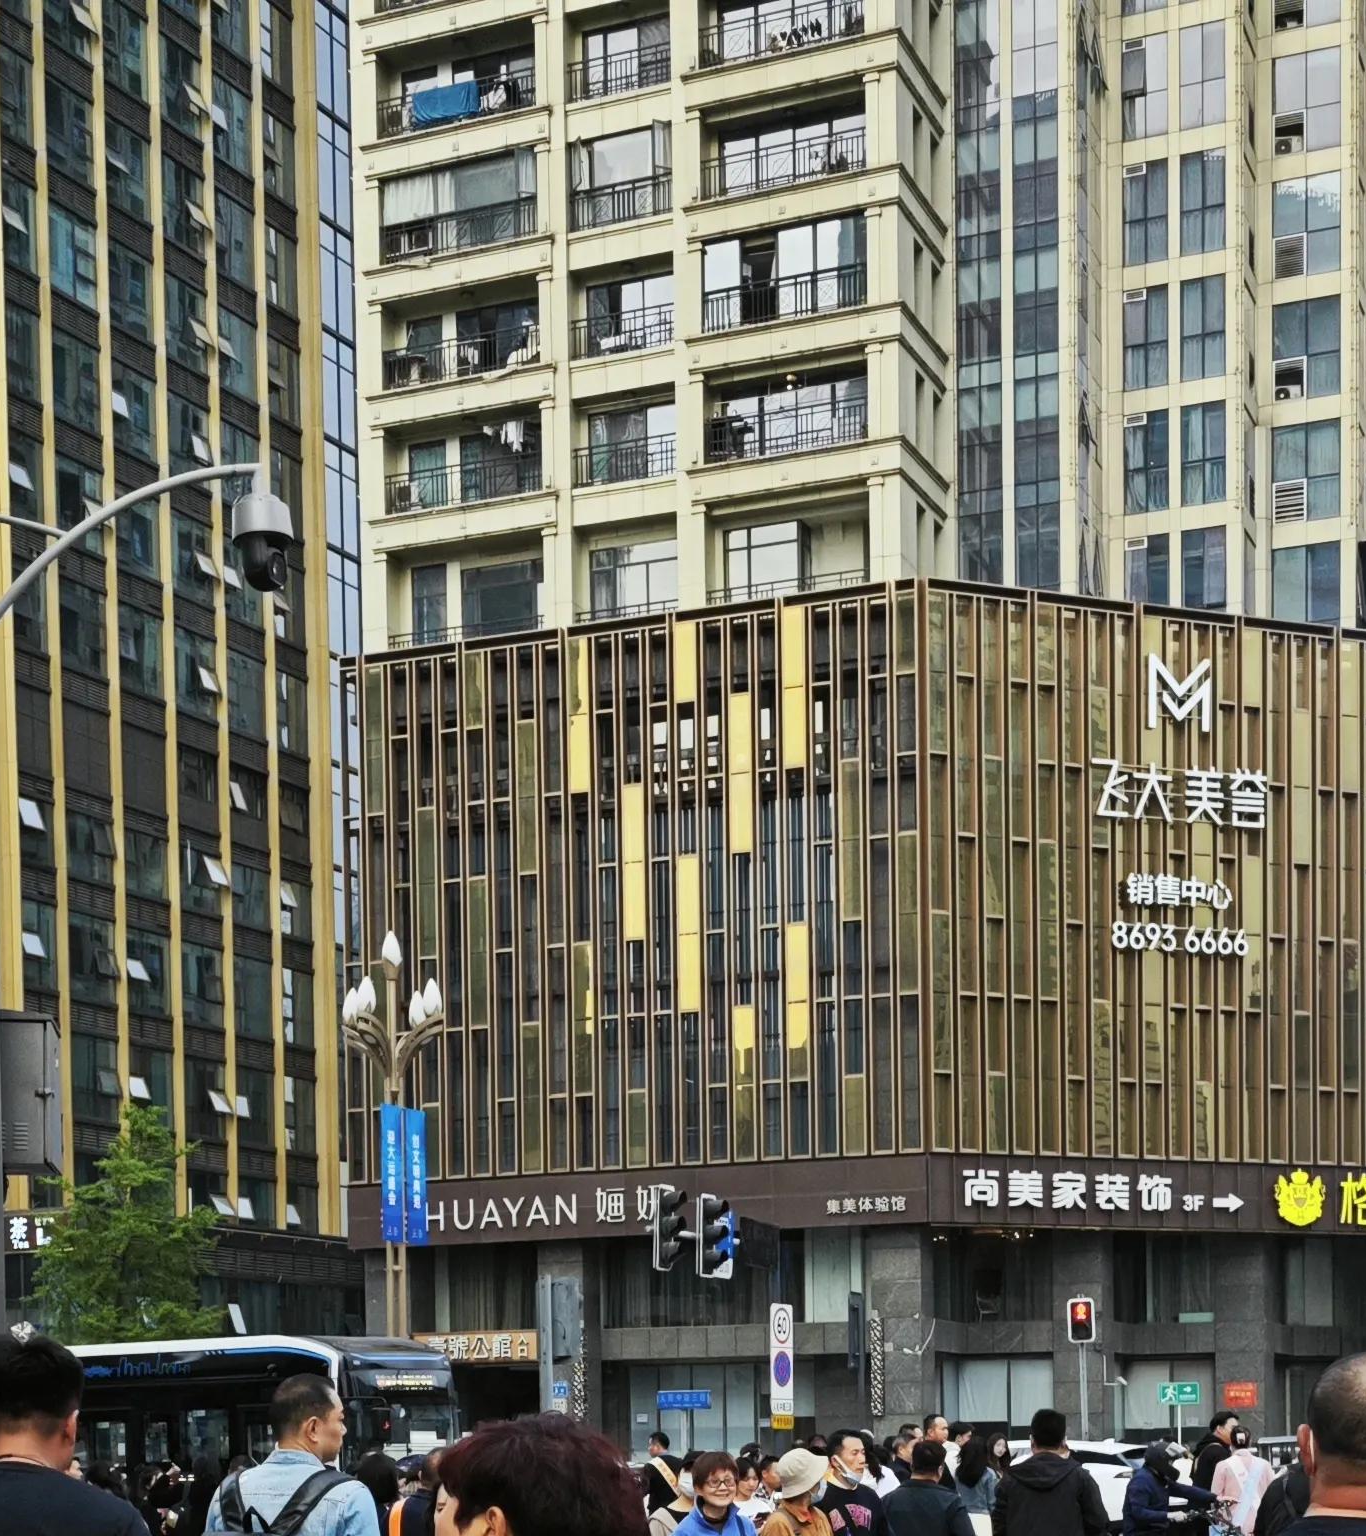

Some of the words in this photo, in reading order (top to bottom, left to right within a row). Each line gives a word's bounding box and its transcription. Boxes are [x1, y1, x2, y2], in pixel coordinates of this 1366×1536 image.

[1125, 870, 1234, 911] 销售中心
[1111, 919, 1178, 952] 8693
[1184, 924, 1250, 958] 6666
[826, 1195, 907, 1215] 集美体验馆
[961, 1168, 1173, 1213] 尚美家装饰
[1182, 1194, 1205, 1213] 3F
[426, 1192, 578, 1232] HUAYAN
[777, 1316, 788, 1335] 60
